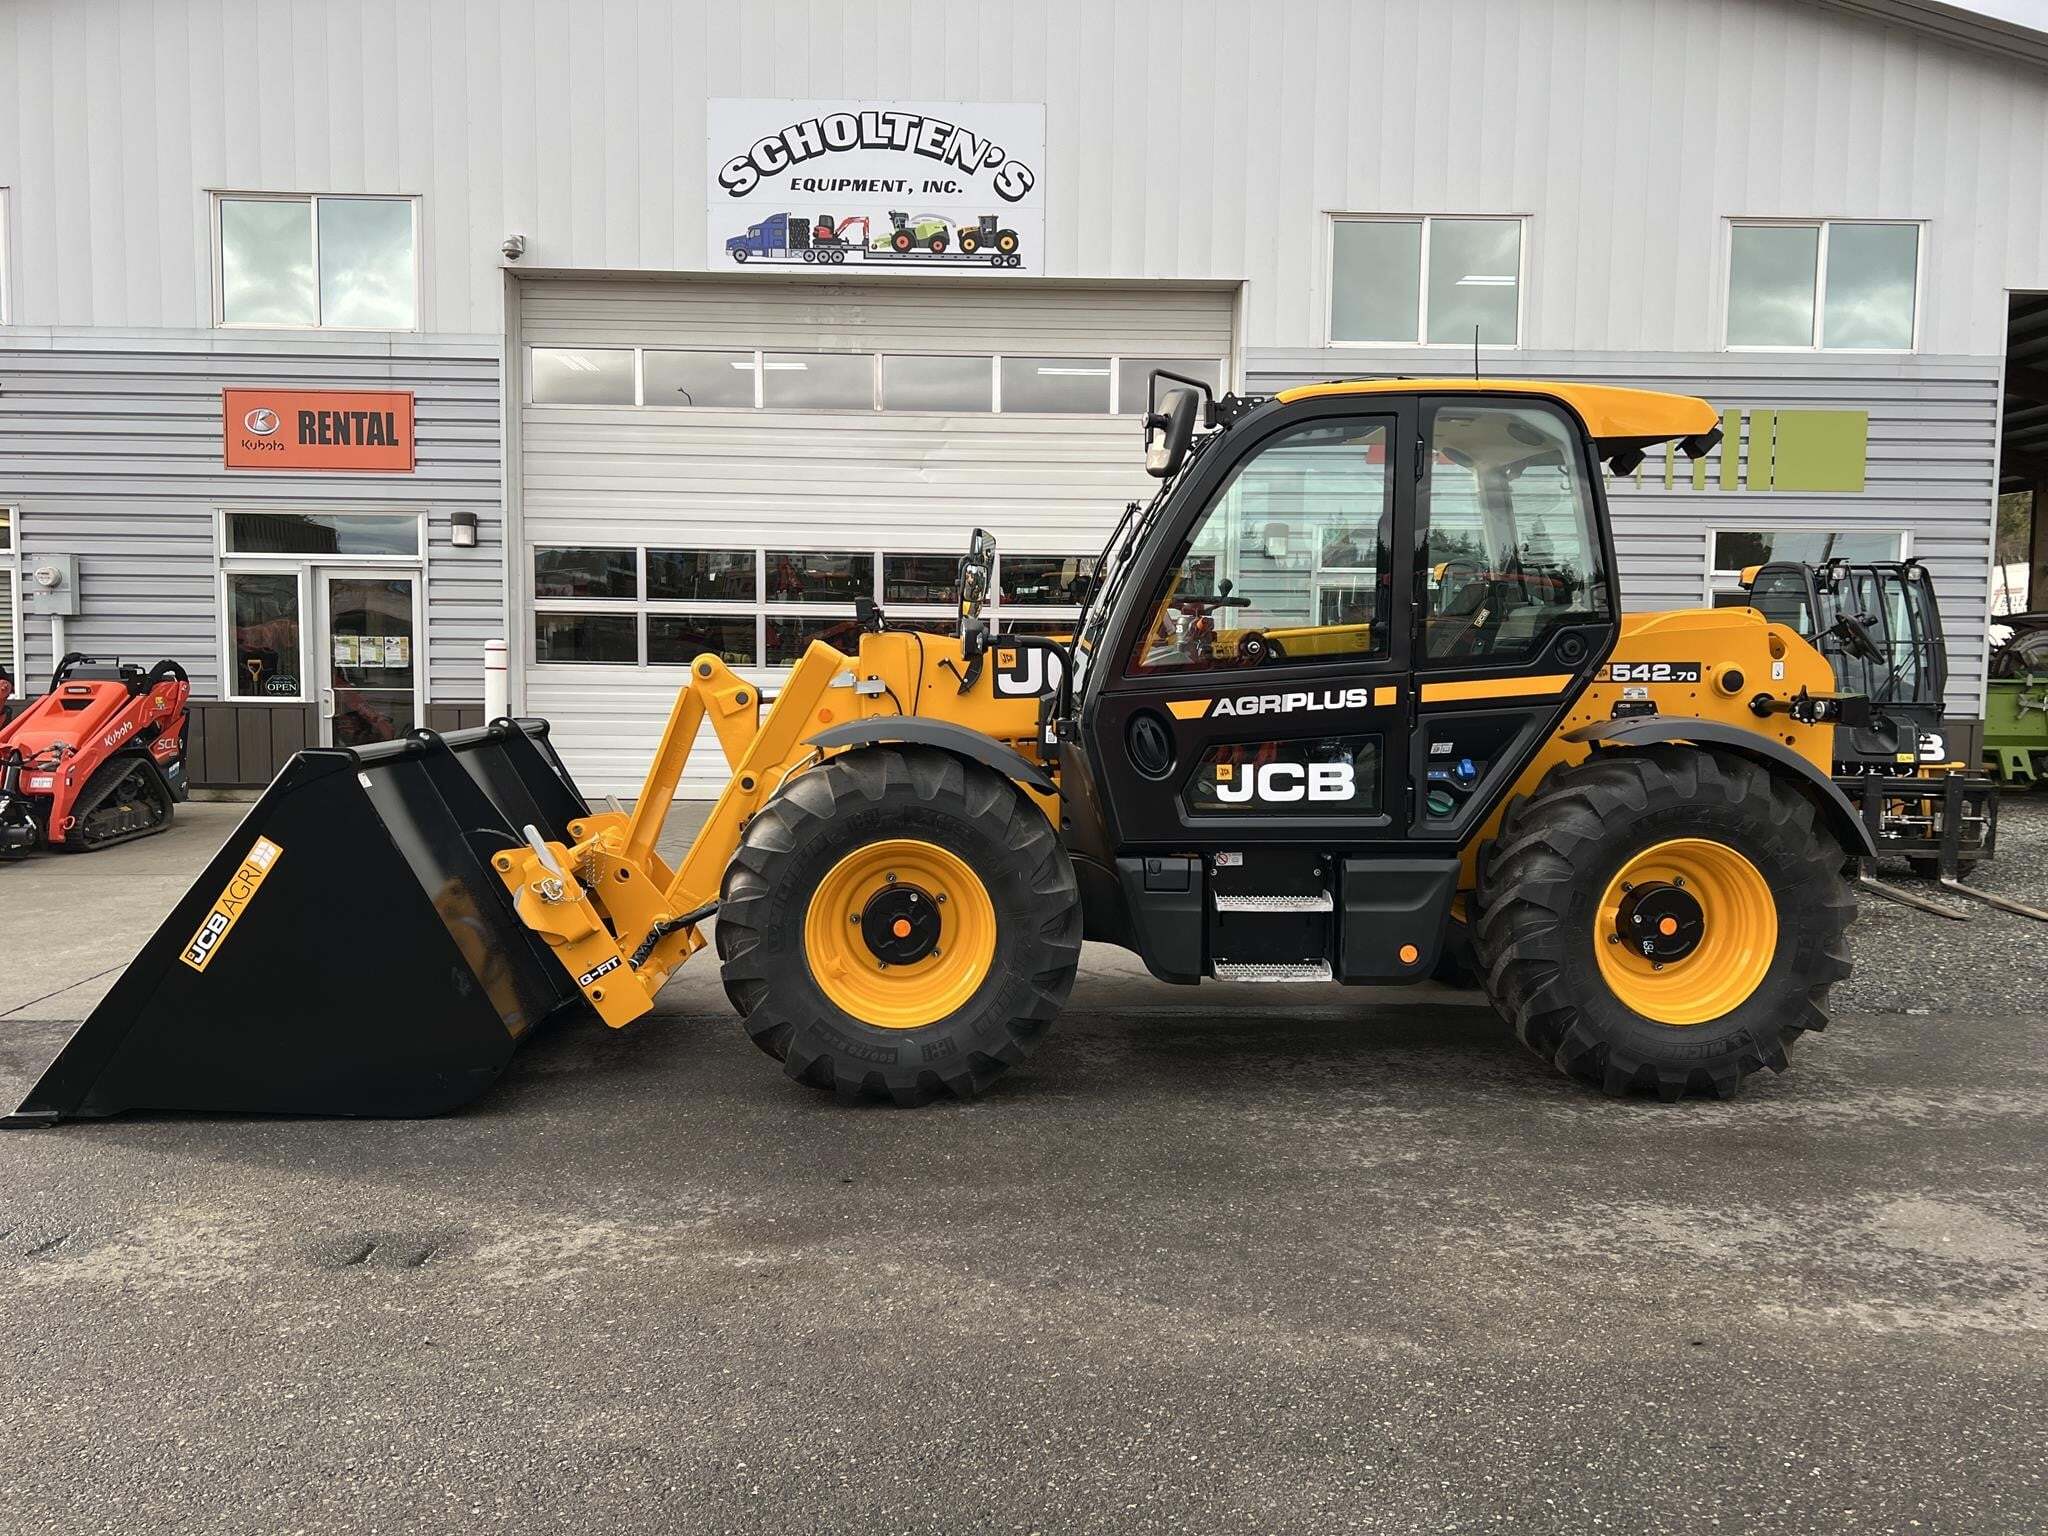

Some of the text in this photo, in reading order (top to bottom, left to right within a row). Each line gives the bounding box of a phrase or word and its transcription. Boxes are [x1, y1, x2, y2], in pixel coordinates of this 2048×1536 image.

[718, 111, 1035, 202] SCHOLTEN'S
[791, 177, 963, 195] EQUIPMENT, INC.
[298, 410, 399, 446] RENTAL
[241, 439, 285, 451] Kubota
[267, 683, 297, 691] OPEN
[1211, 688, 1367, 717] AGRIPLUS
[104, 721, 133, 746] Kubota
[157, 738, 177, 750] SCL
[1216, 762, 1356, 802] JCB
[187, 863, 262, 964] JCB AGRI
[580, 956, 618, 986] Q-FIT
